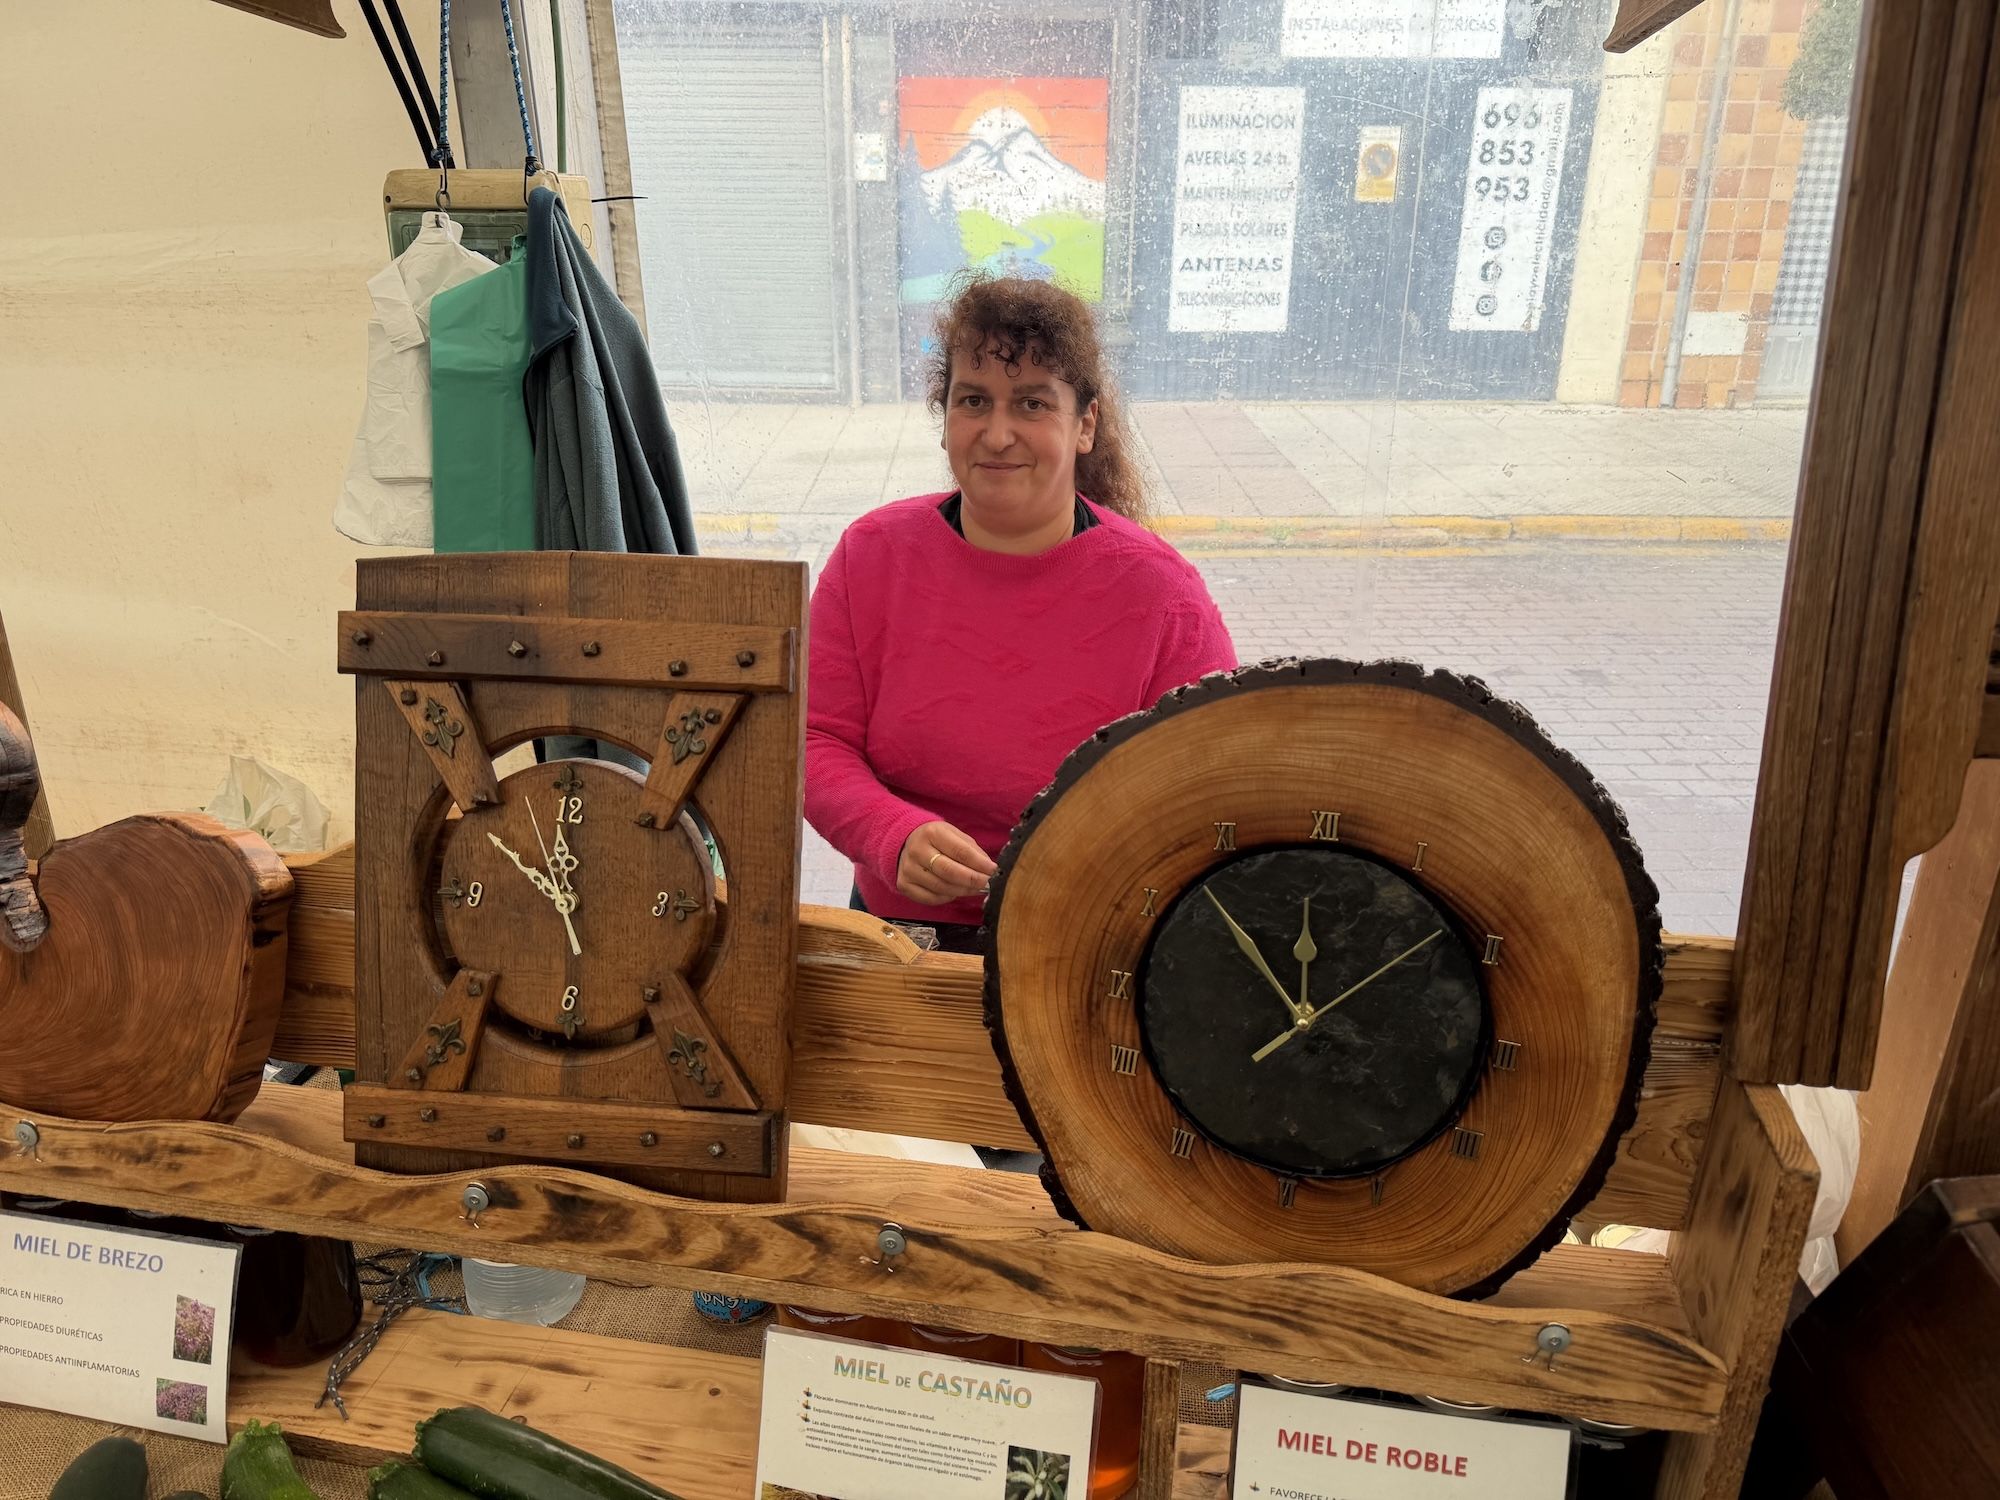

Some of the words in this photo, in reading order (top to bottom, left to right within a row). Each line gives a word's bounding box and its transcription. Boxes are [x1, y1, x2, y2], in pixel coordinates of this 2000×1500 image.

[1287, 17, 1404, 33] INSTALACIONES
[1483, 103, 1541, 129] 696
[1479, 139, 1535, 165] 853
[1475, 176, 1530, 201] 953
[1179, 257, 1284, 272] ANTENAS
[557, 795, 583, 824] 12
[1214, 822, 1236, 851] XI
[1309, 810, 1341, 842] XII
[1412, 842, 1428, 872] I
[467, 882, 483, 908] 9
[652, 892, 669, 918] 3
[1141, 888, 1158, 917] X
[1482, 934, 1503, 966] II
[561, 985, 579, 1011] 6
[1108, 969, 1132, 999] IX
[1111, 1044, 1140, 1076] VIII
[1493, 1039, 1521, 1071] III
[1170, 1126, 1197, 1160] VII
[14, 1233, 60, 1257] MIEL
[66, 1242, 93, 1262] DE
[98, 1246, 164, 1273] BREZO
[0, 1286, 18, 1298] RICA
[20, 1290, 31, 1300] EN
[33, 1292, 64, 1305] HIERRO
[0, 1316, 54, 1333] PROPIEDADES
[55, 1326, 103, 1342] DIURÉTICAS
[0, 1345, 53, 1363] PROPIEDADES
[55, 1355, 140, 1378] ANTIINFLAMATORIAS
[833, 1355, 890, 1385] MIEL
[895, 1375, 911, 1388] DE
[918, 1370, 1032, 1409] CASTAÑO
[831, 1424, 854, 1432] cantidades
[862, 1430, 884, 1438] minerales
[872, 1439, 893, 1448] funciones
[1278, 1428, 1338, 1457] MIEL
[1346, 1440, 1378, 1464] DE
[1386, 1446, 1468, 1477] ROBLE
